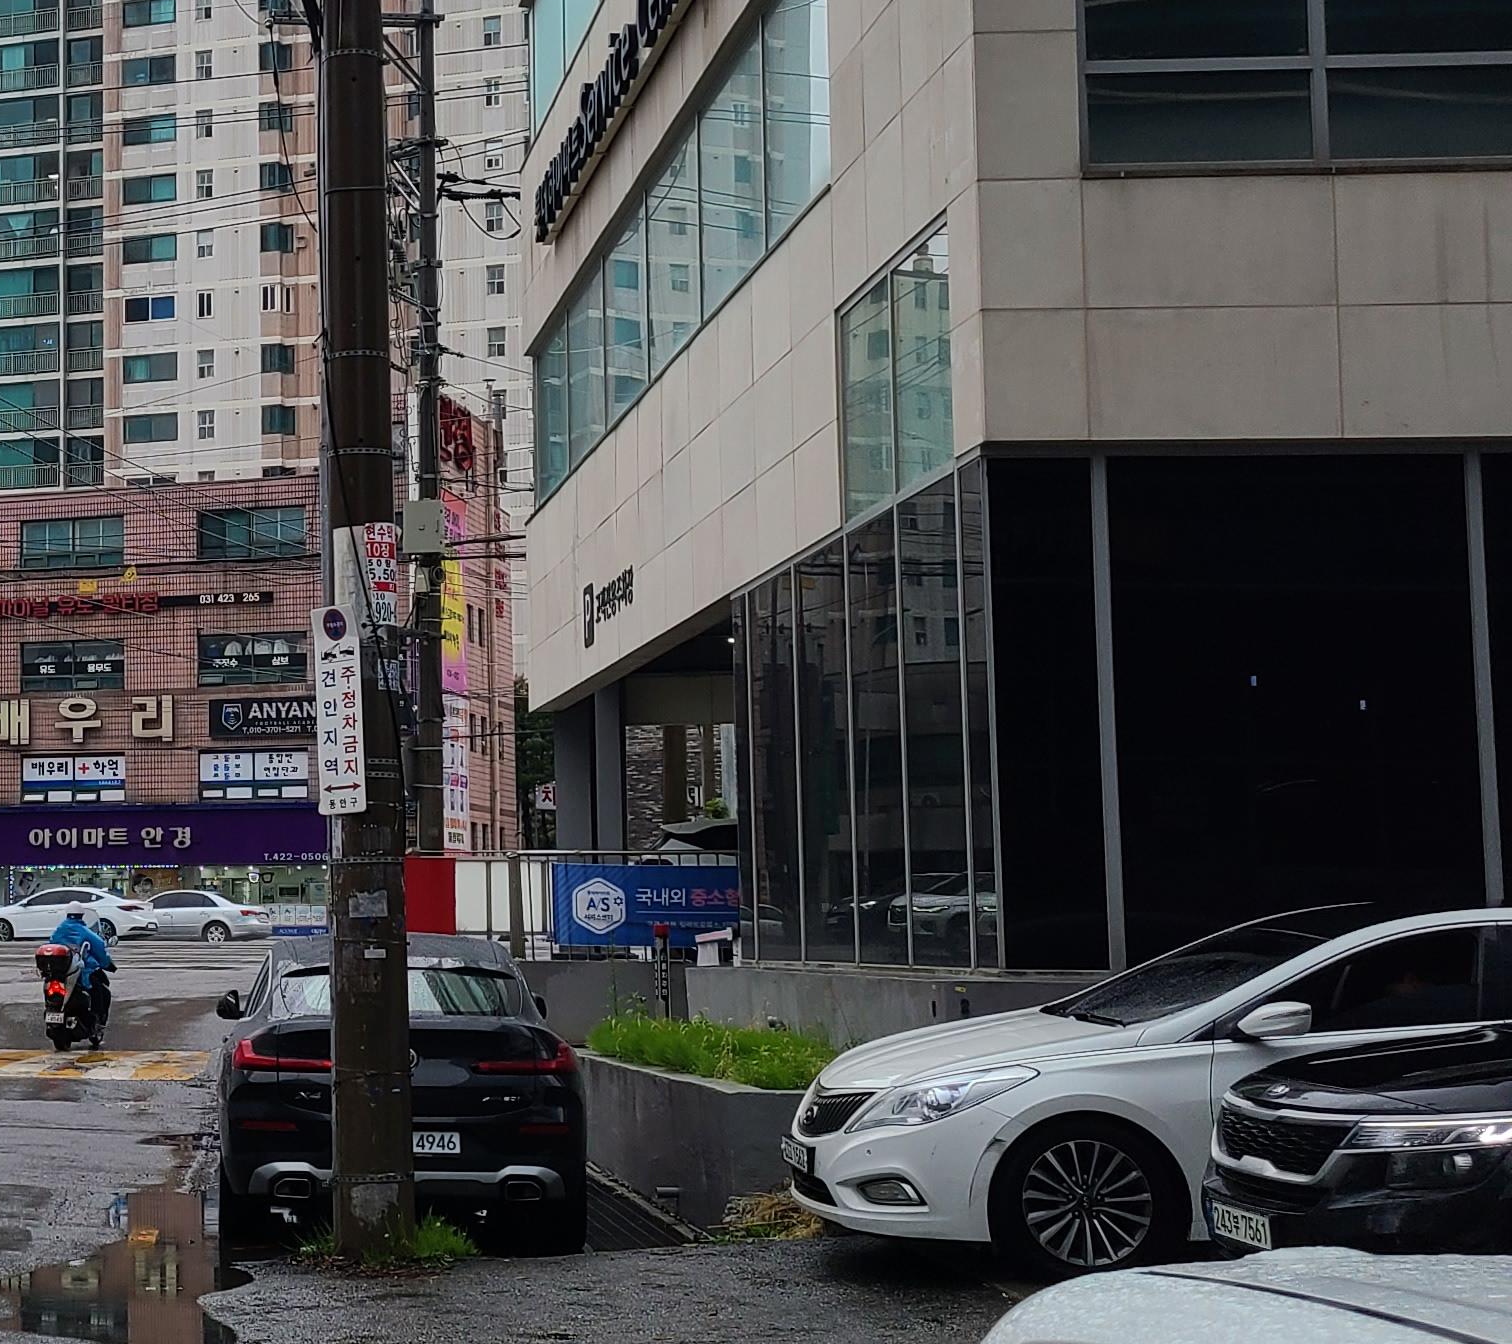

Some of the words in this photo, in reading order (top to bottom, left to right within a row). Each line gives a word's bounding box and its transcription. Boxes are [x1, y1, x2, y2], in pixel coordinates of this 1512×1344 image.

[579, 25, 639, 160] Service
[56, 594, 94, 615] 유도
[199, 594, 215, 605] 031
[217, 593, 235, 603] 423
[31, 761, 69, 777] 배우리
[328, 797, 359, 811] 동안구
[28, 828, 129, 850] 아이마트
[635, 887, 687, 907] 국내외
[414, 1132, 458, 1152] 4946
[1240, 1213, 1268, 1246] 7561
